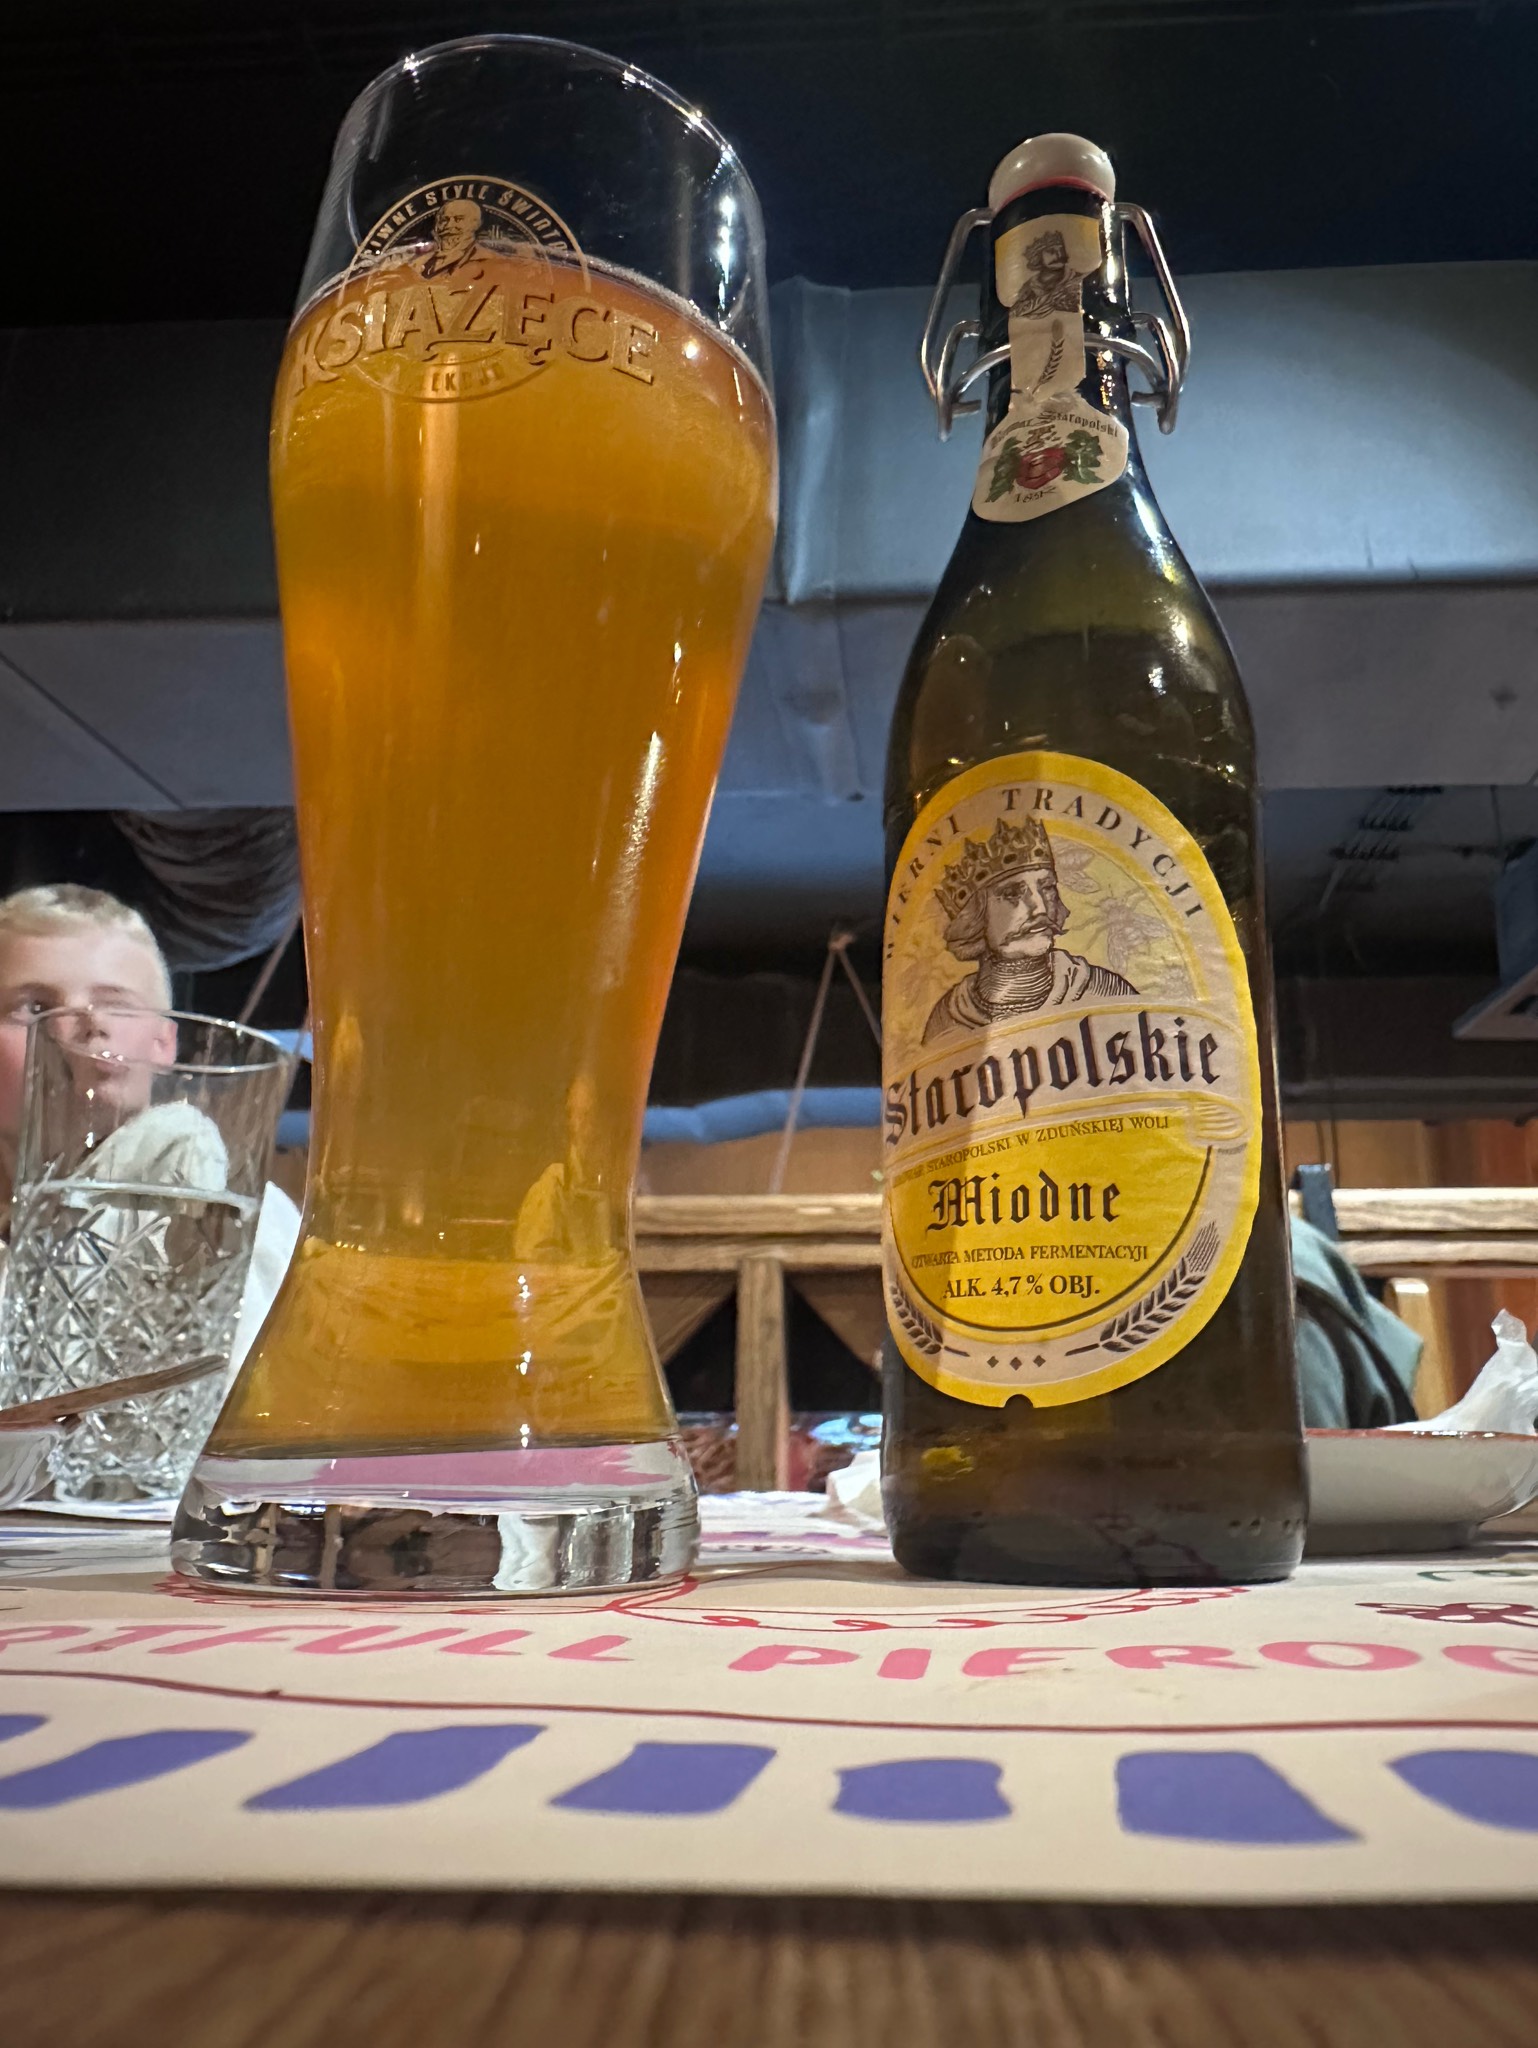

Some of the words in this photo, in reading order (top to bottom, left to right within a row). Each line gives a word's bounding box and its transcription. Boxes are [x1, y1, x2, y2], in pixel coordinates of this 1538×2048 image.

[425, 184, 490, 207] STYLE
[1001, 787, 1205, 918] TRADYCJI
[885, 1010, 1221, 1146] Staropolskie
[927, 1136, 1011, 1173] STAROPOLSKI
[1015, 1131, 1030, 1146] W
[1035, 1119, 1124, 1142] ZDUŃSKIEJ
[1129, 1115, 1169, 1129] WOLI
[924, 1168, 1122, 1234] Miodne
[963, 1246, 1026, 1264] METODA
[941, 1277, 988, 1300] ALK.
[1049, 1274, 1101, 1299] OBJ.
